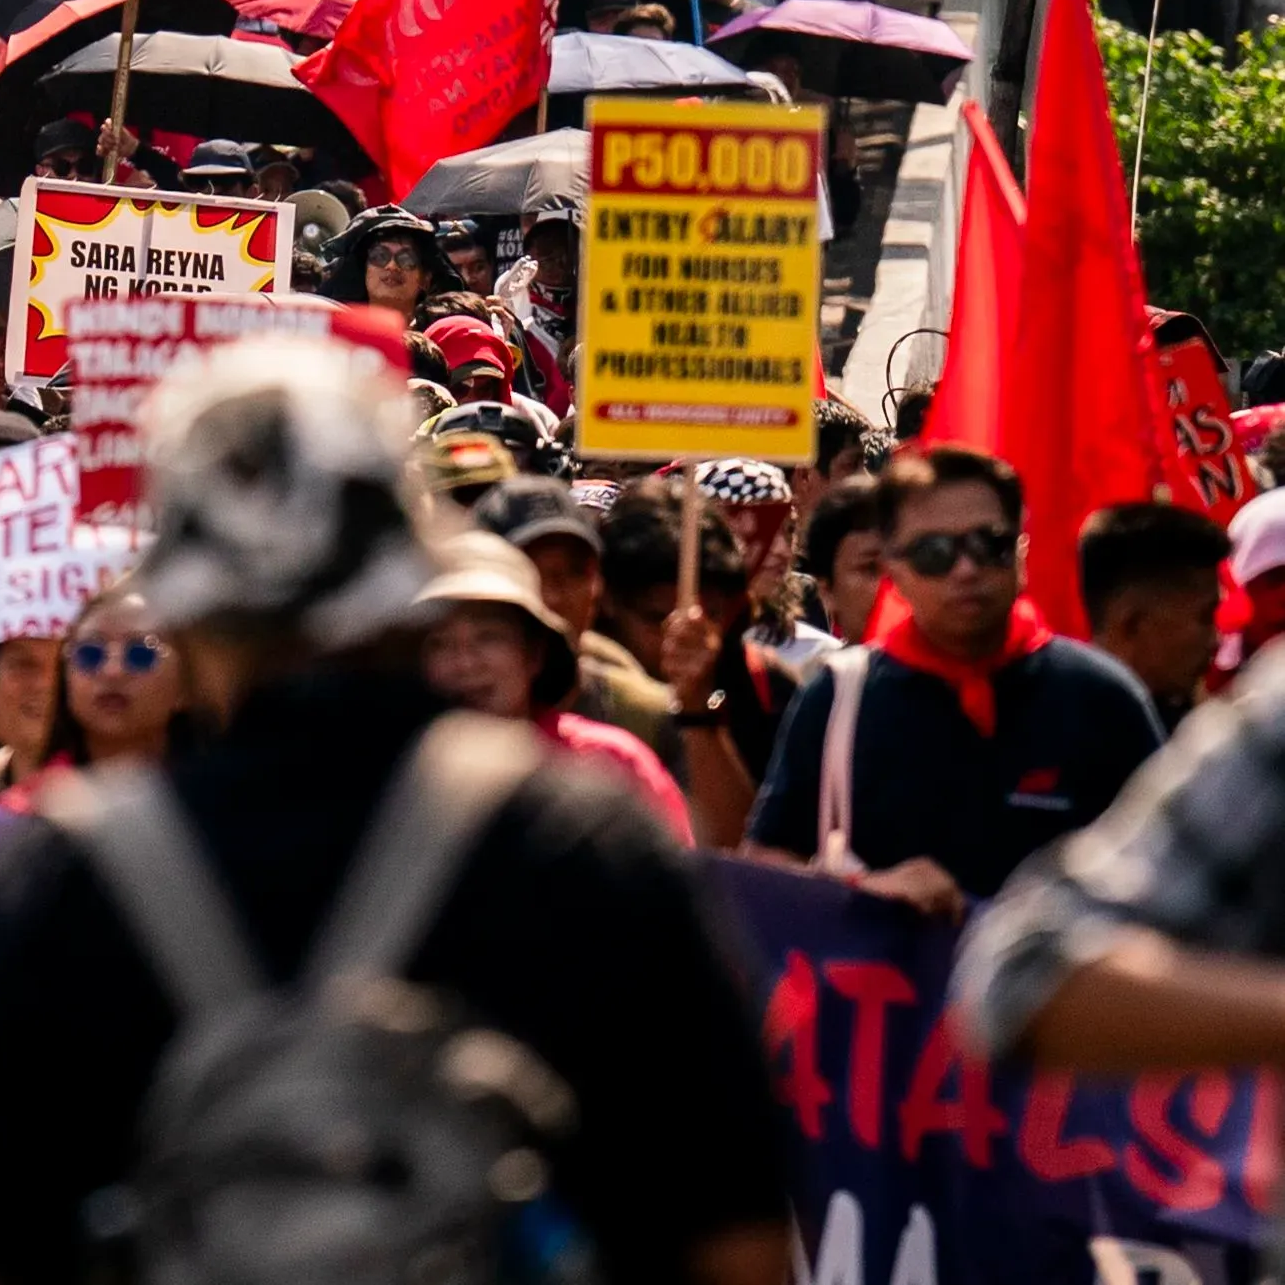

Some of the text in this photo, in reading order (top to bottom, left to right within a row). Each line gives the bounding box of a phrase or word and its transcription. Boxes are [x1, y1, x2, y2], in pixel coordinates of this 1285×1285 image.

[602, 130, 810, 194] P50,000
[596, 207, 690, 242] ENTRY
[70, 239, 226, 281] SARA REYNA
[84, 273, 119, 301] NG
